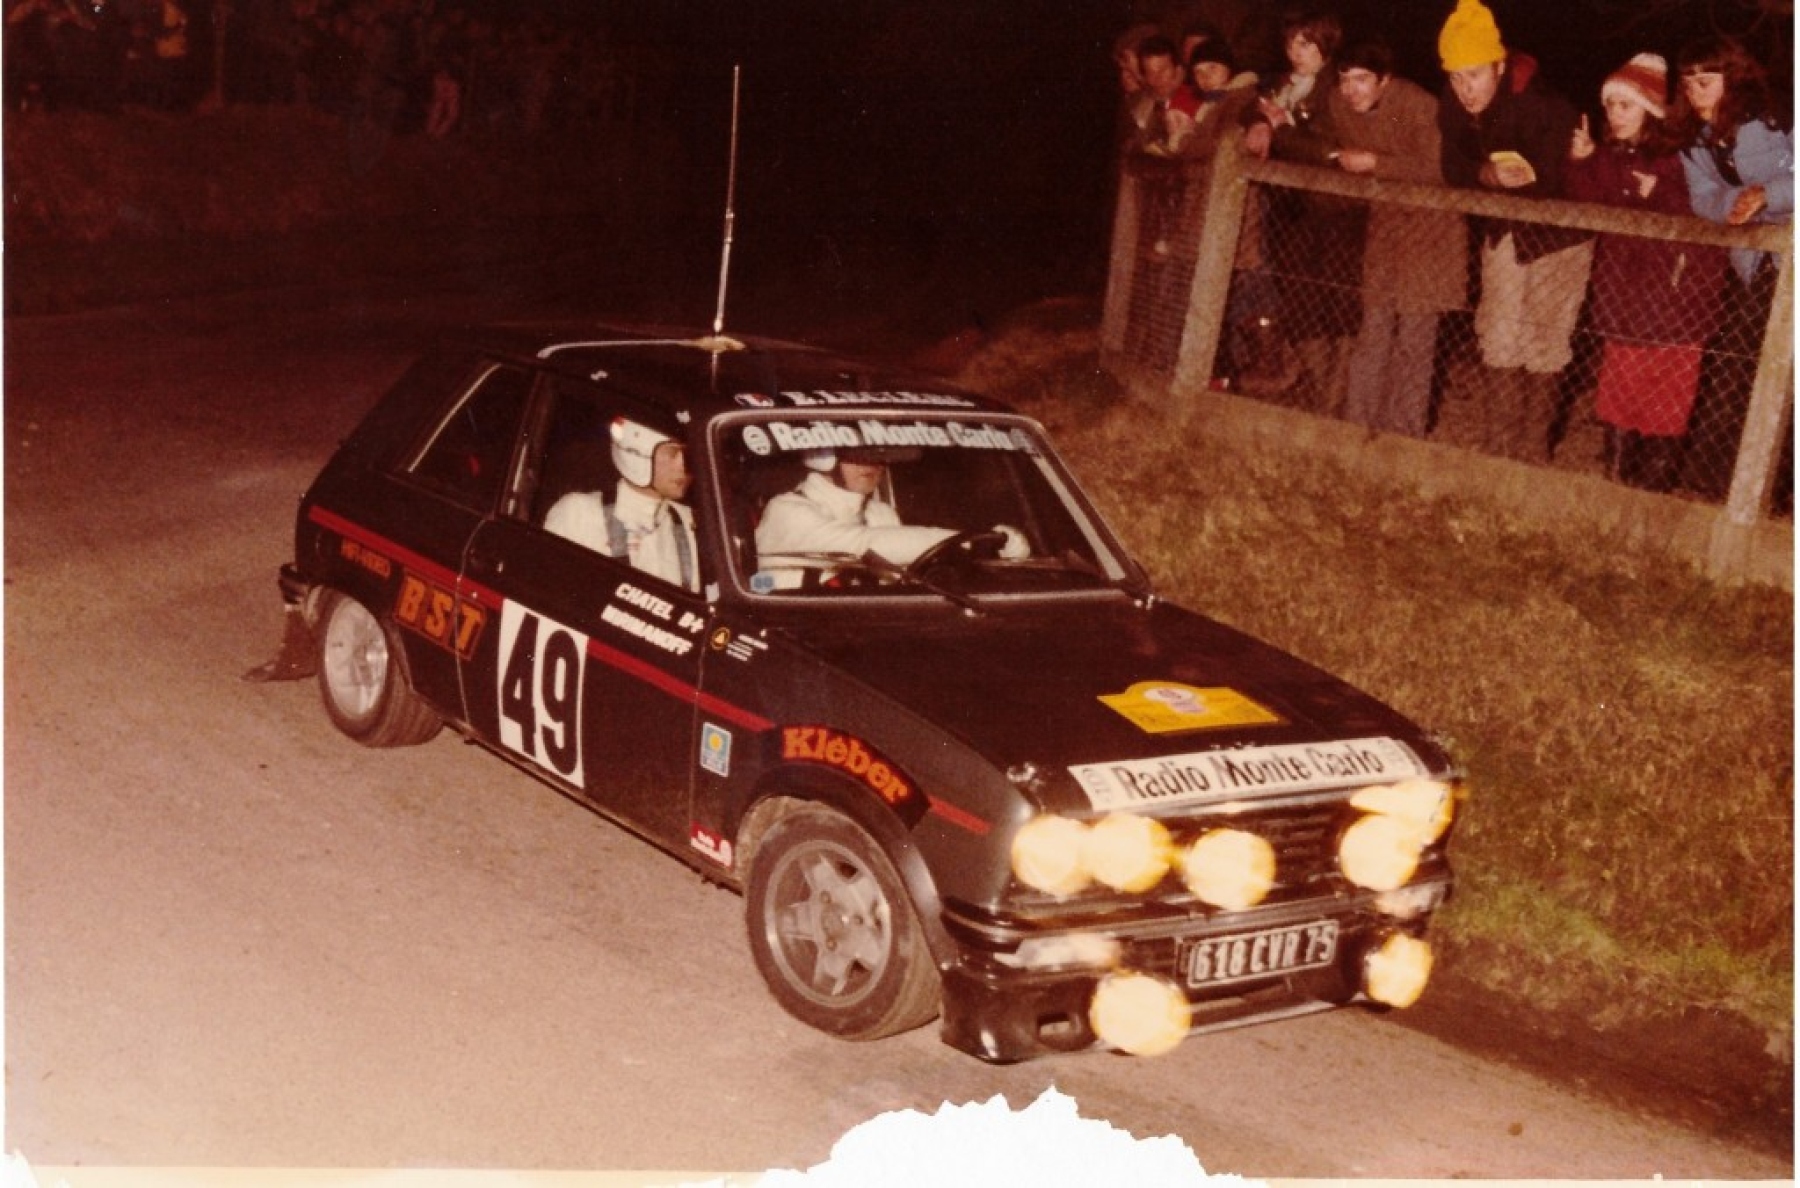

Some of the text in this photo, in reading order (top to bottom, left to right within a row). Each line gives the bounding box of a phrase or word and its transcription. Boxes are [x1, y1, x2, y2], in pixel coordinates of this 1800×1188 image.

[769, 421, 857, 450] Radio
[858, 420, 947, 448] Monte
[398, 575, 486, 652] BST
[615, 583, 674, 620] CHATEL
[502, 612, 580, 775] 49
[1111, 760, 1208, 801] Radio
[1207, 754, 1311, 789] Monte
[1308, 747, 1386, 778] Carlo
[1195, 938, 1247, 981] 618
